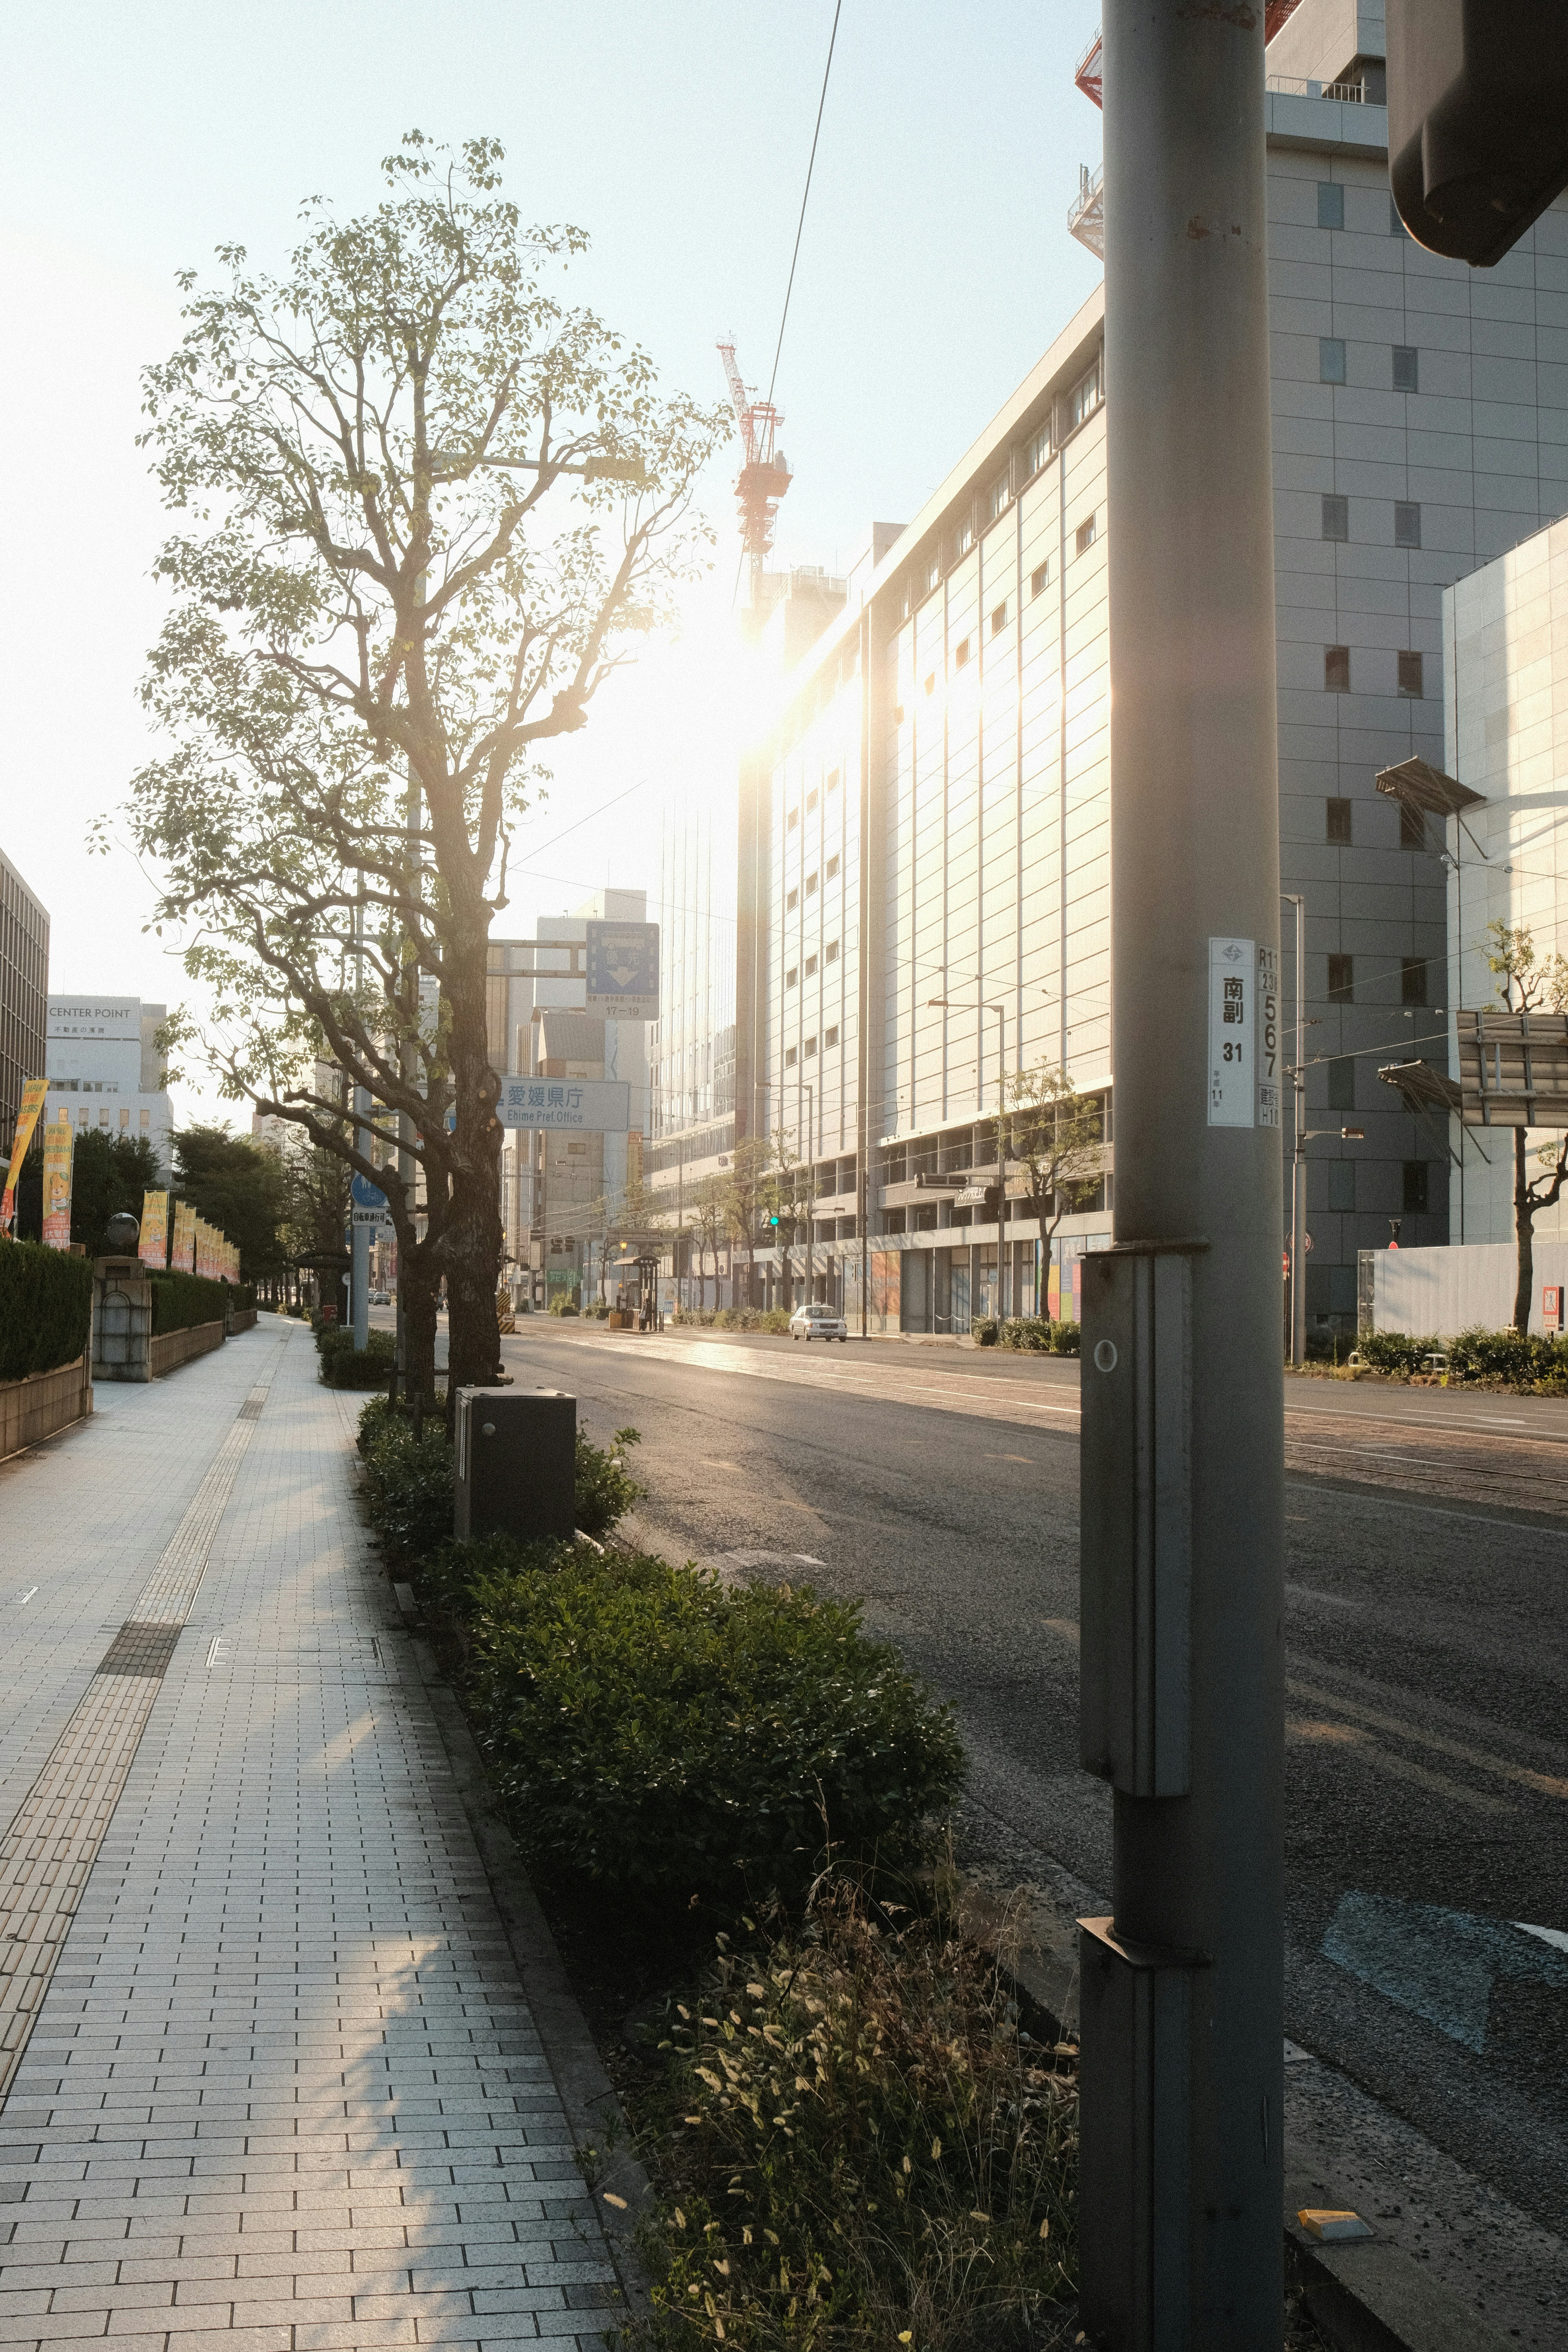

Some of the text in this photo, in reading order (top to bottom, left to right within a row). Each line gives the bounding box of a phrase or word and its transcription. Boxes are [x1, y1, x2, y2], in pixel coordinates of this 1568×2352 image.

[1223, 976, 1244, 1024] 南副
[49, 1007, 131, 1018] CENTER POINT
[1223, 1042, 1242, 1062] 31
[508, 1085, 584, 1109] 愛媛県庁
[508, 1109, 534, 1122] Ehime
[557, 1111, 583, 1123] Office
[354, 1212, 385, 1222] 自転車通行可
